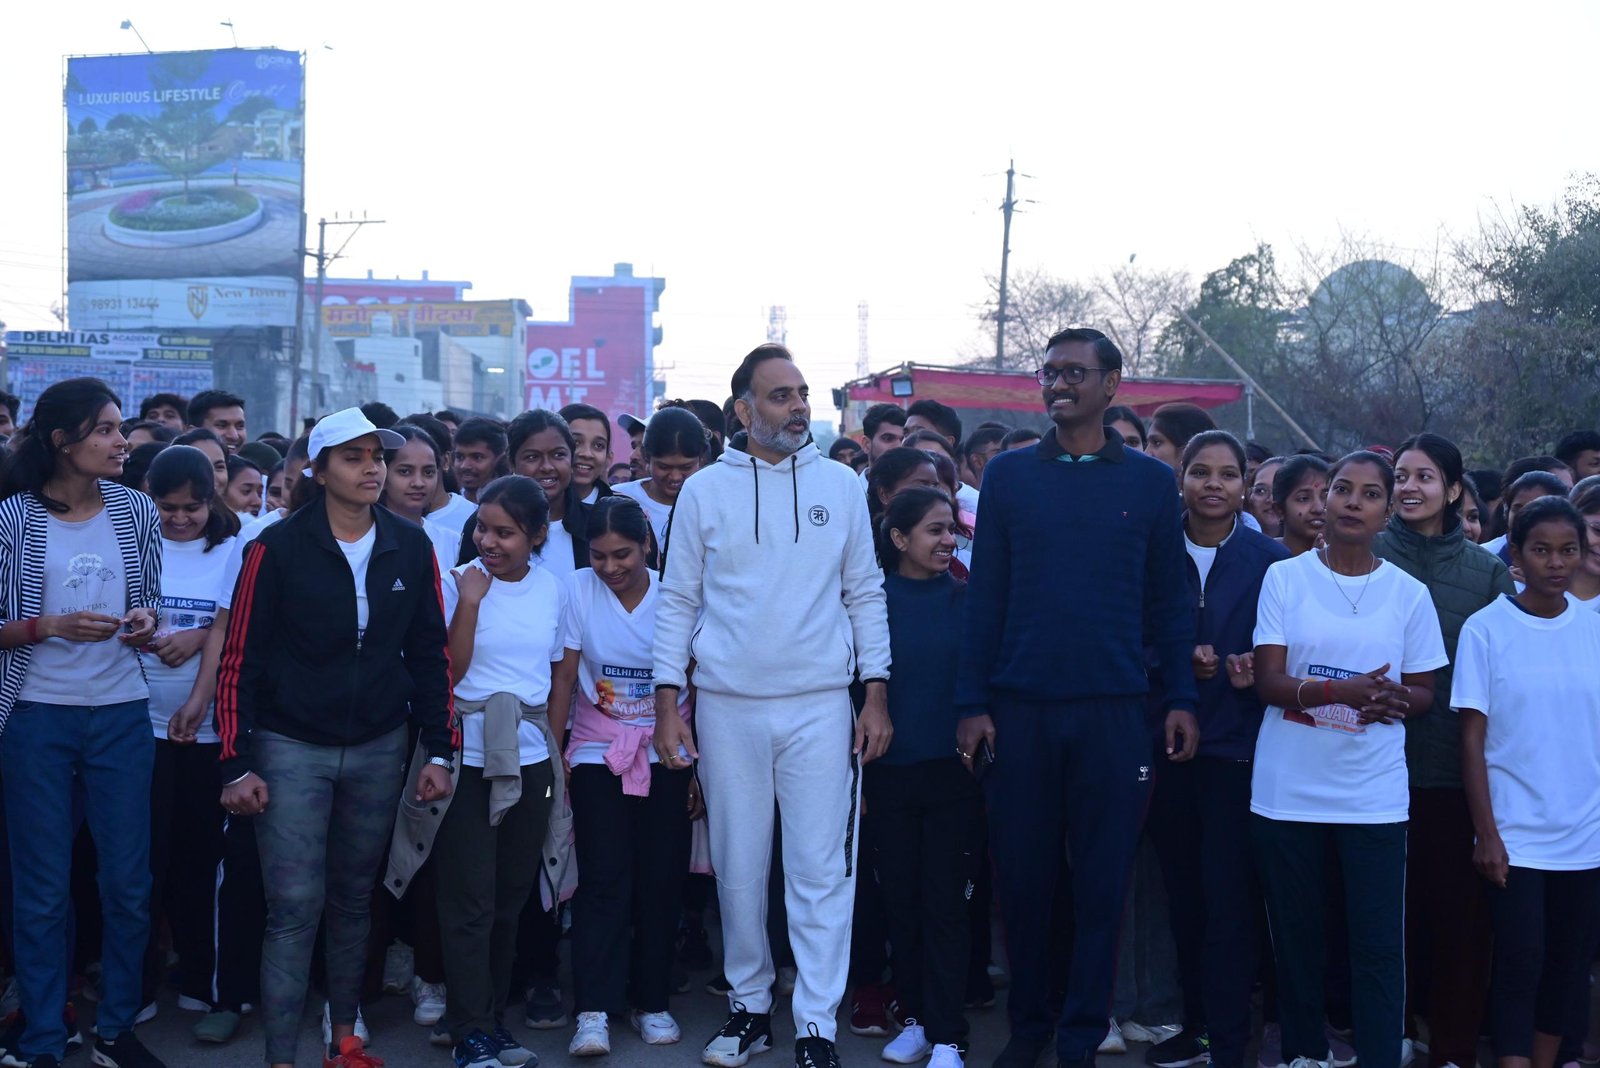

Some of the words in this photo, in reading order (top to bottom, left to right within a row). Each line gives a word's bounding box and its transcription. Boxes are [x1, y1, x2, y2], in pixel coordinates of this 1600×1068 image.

[79, 90, 150, 106] LUXURIOUS
[153, 87, 221, 103] LIFESTYLE
[214, 287, 242, 298] New
[247, 287, 287, 298] Town
[90, 297, 122, 310] 98931
[23, 331, 75, 343] DELHI
[80, 333, 110, 345] IAS
[112, 334, 155, 342] ACADEMY
[177, 599, 193, 608] IAS
[61, 606, 77, 614] KEY
[605, 666, 631, 677] DELHI
[633, 669, 649, 678] IAS
[1311, 666, 1335, 677] DELHI
[1336, 670, 1349, 680] IAS
